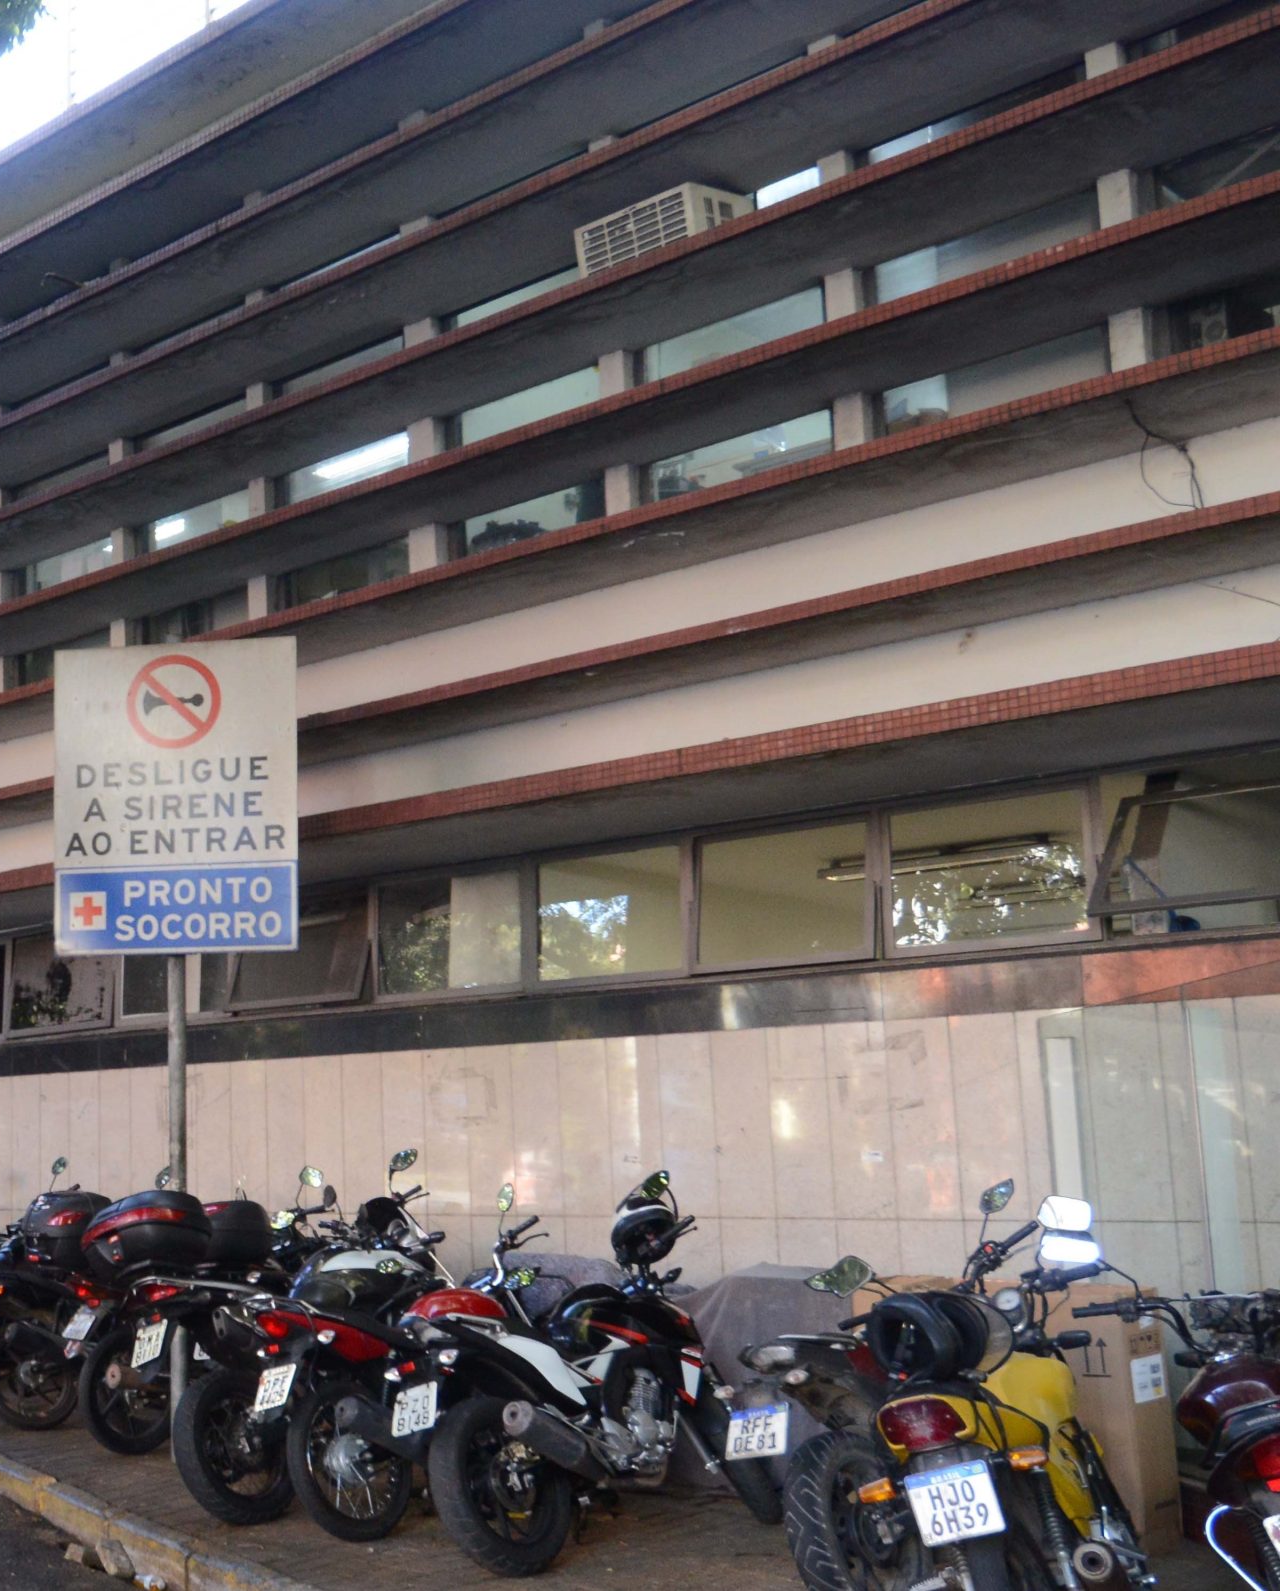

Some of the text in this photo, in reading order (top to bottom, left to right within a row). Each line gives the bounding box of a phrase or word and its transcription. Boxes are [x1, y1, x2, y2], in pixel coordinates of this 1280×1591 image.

[76, 756, 269, 789] DESLIGUE
[83, 792, 263, 822] A SIRENE
[65, 824, 286, 857] AO ENTRAR
[123, 876, 273, 908] PRONTO
[114, 910, 282, 942] SOCORRO
[397, 1410, 430, 1431] 8148
[741, 1415, 773, 1435] RFF
[931, 1503, 989, 1536] 6H39
